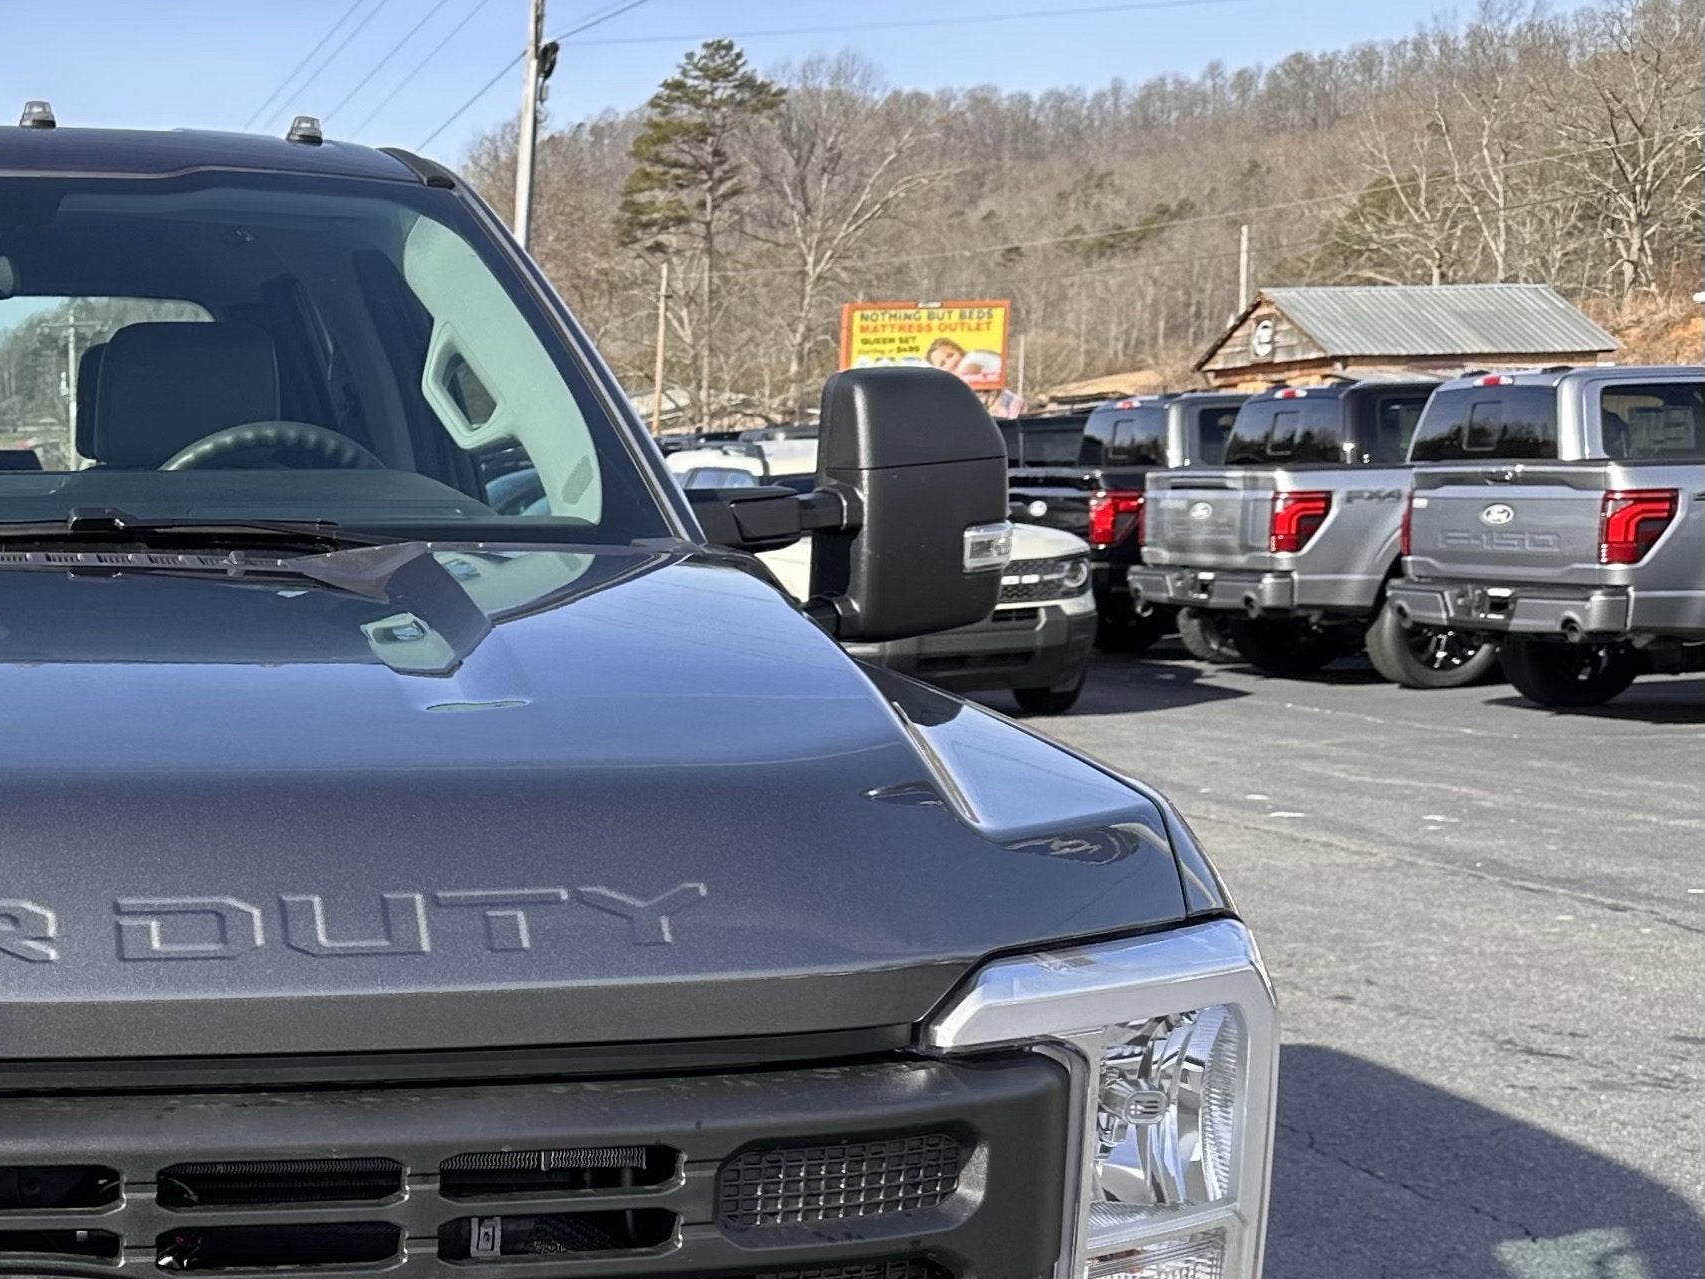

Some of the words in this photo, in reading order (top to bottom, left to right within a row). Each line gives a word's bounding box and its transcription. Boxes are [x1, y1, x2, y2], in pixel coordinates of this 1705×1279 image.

[859, 312, 922, 322] NOTHING
[927, 311, 953, 320] BUT
[959, 309, 993, 320] BEDS
[859, 323, 933, 333] MATTRESS
[937, 322, 993, 332] OUTLET
[860, 337, 896, 345] QUEEN
[898, 336, 917, 344] SET
[1345, 489, 1402, 504] FX4
[1438, 530, 1560, 551] F-150
[114, 882, 708, 961] DUTY
